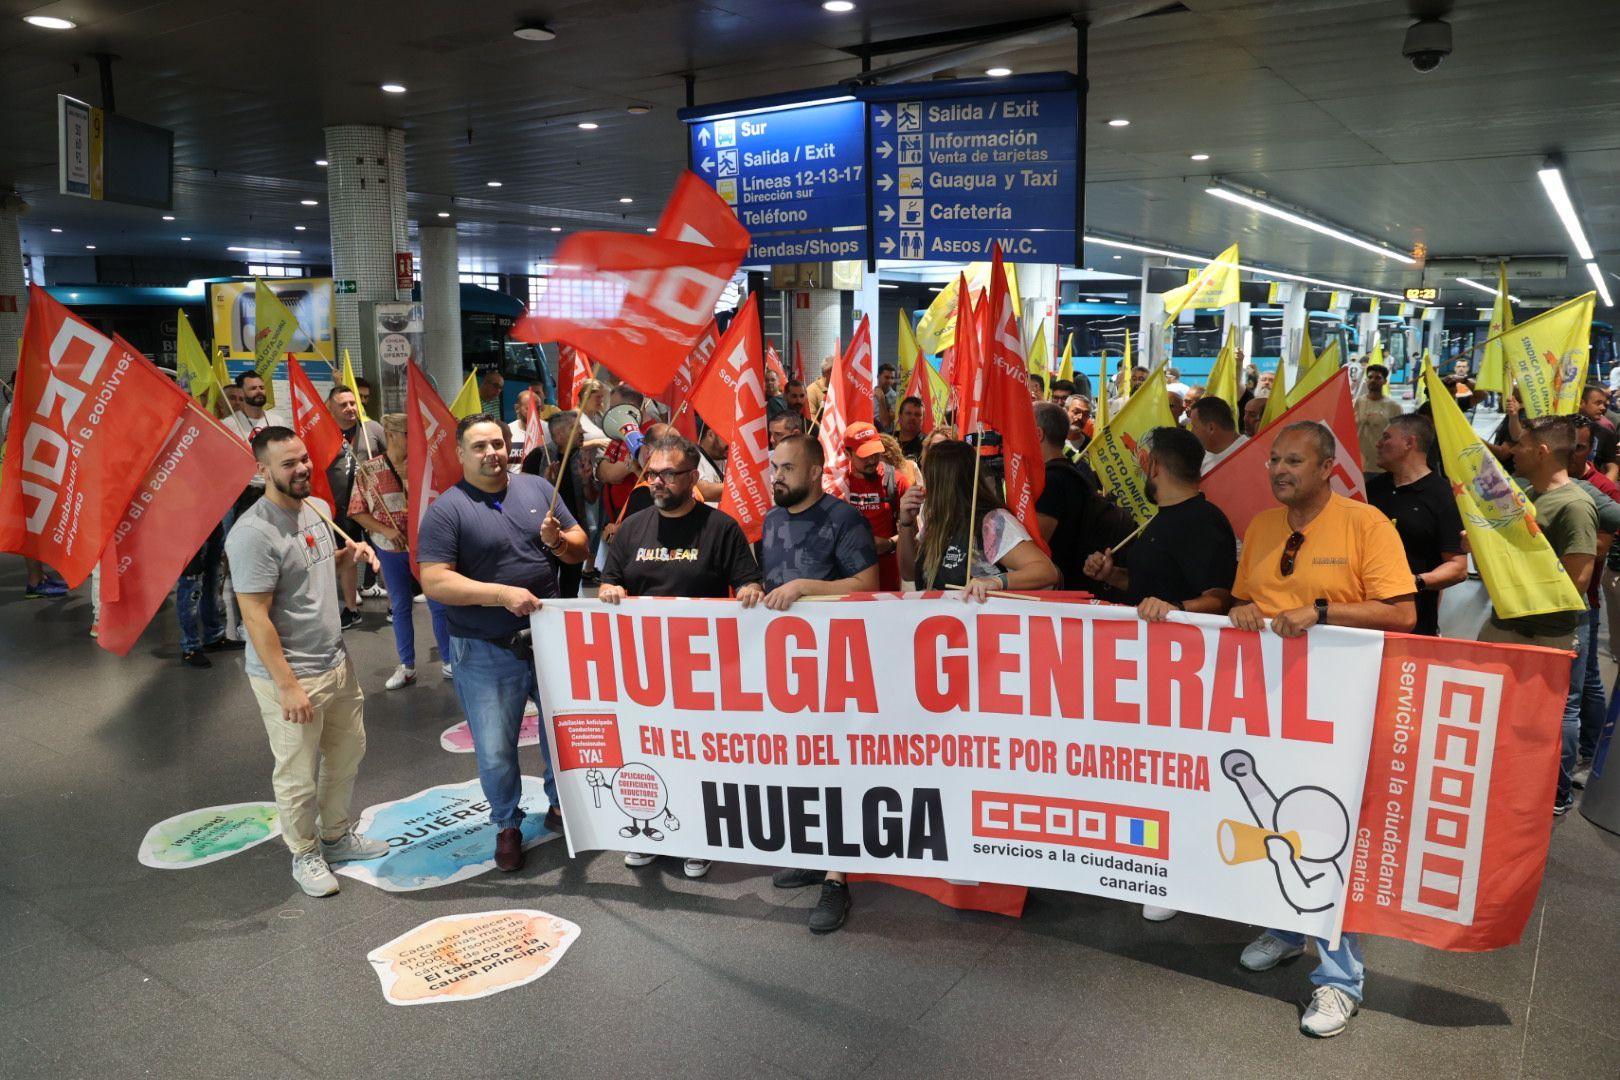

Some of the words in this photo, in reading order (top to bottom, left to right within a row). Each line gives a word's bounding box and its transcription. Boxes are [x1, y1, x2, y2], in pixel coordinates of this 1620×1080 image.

[928, 105, 983, 122] Salida
[989, 102, 997, 119] /
[1003, 101, 1039, 118] Exit
[741, 121, 767, 137] Sur
[930, 129, 1037, 149] Información
[743, 149, 789, 167] Salida
[794, 147, 800, 161] /
[805, 143, 835, 160] Exit
[930, 151, 967, 164] Venta
[971, 150, 988, 162] de
[993, 148, 1048, 163] tarjetas
[743, 176, 791, 192] Líneas
[796, 166, 863, 186] 12-13-17
[929, 171, 997, 190] Guagua
[1004, 174, 1015, 190] y
[1021, 169, 1058, 187] Taxi
[744, 189, 792, 203] Dirección
[796, 189, 814, 198] sur
[744, 209, 807, 225] Teléfono
[930, 203, 1012, 220] Cafetería
[747, 240, 859, 258] Tiendas/Shops
[984, 237, 992, 253] /
[998, 237, 1037, 254] W.C.
[1521, 336, 1545, 385] SINDICATO
[1519, 360, 1528, 372] DE
[1524, 374, 1542, 415] GUAGUA
[1097, 447, 1108, 464] DE
[1105, 465, 1138, 520] GUAGUAS
[1103, 426, 1128, 476] NDICATO
[1124, 476, 1153, 520] UNIFICA
[564, 611, 879, 714] HUELGA
[914, 613, 1334, 744] GENERAL
[1393, 661, 1416, 755] servicios
[579, 749, 604, 764] ¡YA!
[639, 725, 666, 757] EN
[671, 729, 696, 760] EL
[702, 732, 788, 766] SECTOR
[796, 734, 839, 766] DEL
[847, 734, 1000, 770] TRANSPORTE
[1009, 737, 1057, 774] POR
[1066, 742, 1210, 793] CARRETERA
[1391, 759, 1406, 771] a
[1424, 680, 1485, 849] CCOO
[618, 780, 659, 790] COEFICIENTES
[620, 771, 655, 781] APLICACIÓN
[1389, 776, 1408, 794] la
[620, 788, 658, 798] REDUCTORES
[624, 797, 656, 807] CCOO
[386, 800, 490, 847] QUIÉRE
[404, 816, 424, 825] No
[700, 780, 949, 862] HUELGA
[981, 801, 1106, 840] CCOO
[427, 833, 463, 851] libre
[464, 825, 484, 836] de
[973, 842, 1043, 859] servicios
[1049, 851, 1057, 861] a
[1062, 849, 1075, 863] la
[1080, 853, 1168, 877] ciudadanía
[1352, 827, 1371, 903] canarias
[1375, 800, 1405, 907] ciudadanía
[1100, 876, 1168, 897] canarias
[399, 942, 434, 958] Cada
[437, 933, 460, 946] año
[463, 916, 512, 936] fallecen
[400, 957, 418, 967] en
[420, 936, 477, 961] Canarias
[479, 926, 505, 938] más
[509, 919, 524, 928] de
[444, 933, 503, 959] personas
[506, 925, 528, 938] por
[414, 957, 459, 977] cáncer
[463, 949, 480, 960] de
[424, 971, 440, 983] El
[444, 952, 500, 976] tabaco
[504, 943, 522, 953] es
[525, 937, 539, 946] la
[429, 970, 478, 992] causa
[482, 942, 551, 974] principal
